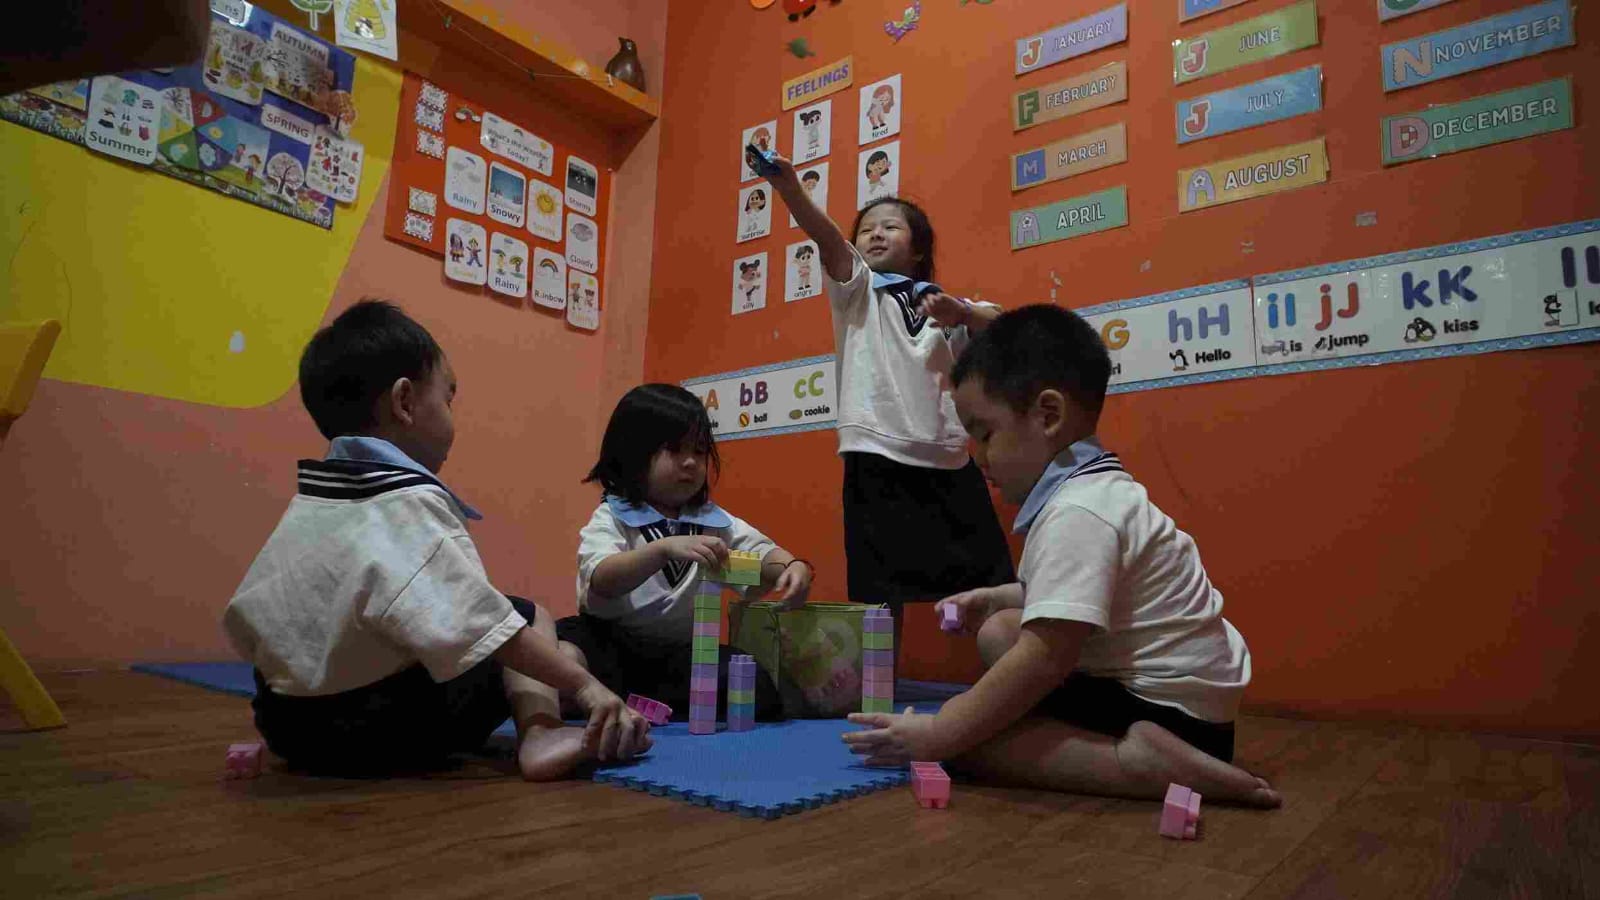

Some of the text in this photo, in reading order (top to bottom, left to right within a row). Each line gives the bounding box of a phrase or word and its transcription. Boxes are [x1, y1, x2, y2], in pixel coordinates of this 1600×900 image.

[275, 30, 327, 61] AUTUMN
[1020, 19, 1114, 69] J JANUARY
[1180, 26, 1281, 75] J JUNE
[1392, 15, 1561, 84] N NOVEMBER
[787, 63, 849, 100] FEELINGS
[1046, 74, 1118, 110] FEBRUARY
[266, 113, 310, 139] SPRING
[1184, 88, 1285, 136] J JULY
[871, 126, 889, 139] tired
[1390, 97, 1559, 159] D DECEMBER
[89, 130, 152, 158] Summer
[1057, 140, 1107, 167] MARCH
[1223, 152, 1312, 192] AUGUST
[453, 192, 478, 209] Rainy
[491, 204, 521, 224] Snowy
[1056, 202, 1106, 230] APRIL
[570, 254, 593, 270] Cloudy
[495, 277, 520, 294] Rainy
[793, 288, 813, 300] angry
[1401, 265, 1478, 310] kK
[1101, 303, 1231, 351] G hH
[1290, 318, 1480, 353] is jump kiss
[1195, 348, 1231, 365] Hello
[703, 388, 720, 411] A
[753, 404, 831, 424] ball cookie
